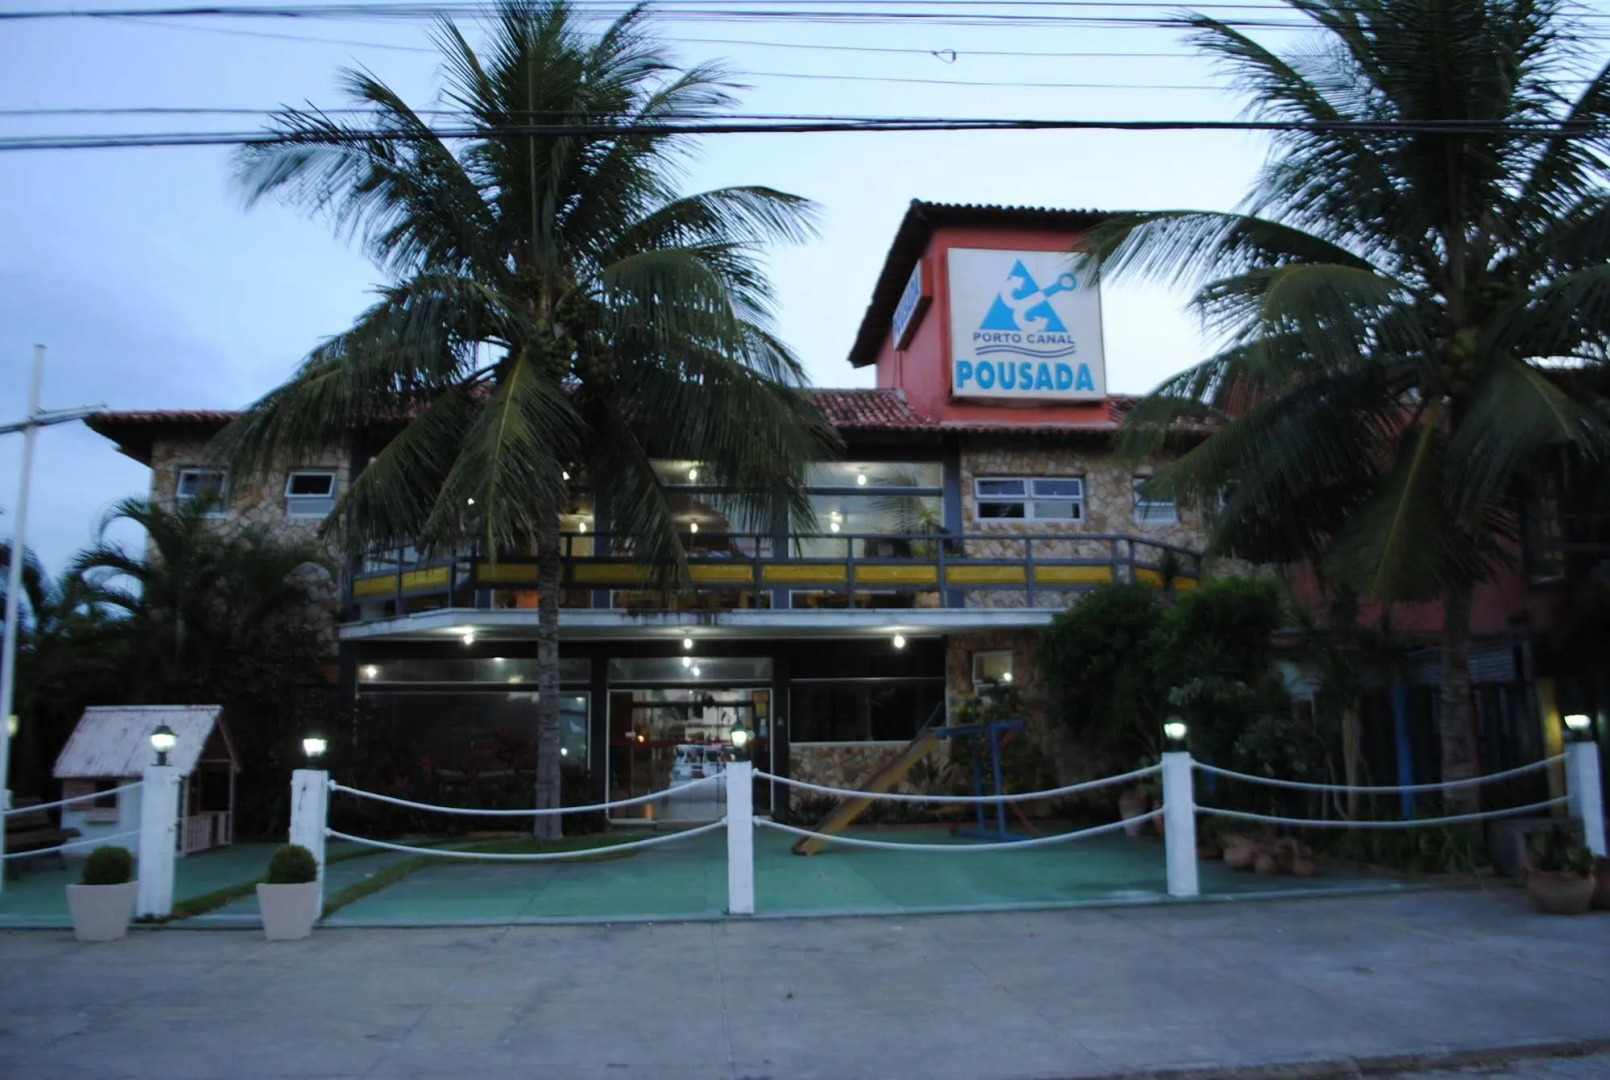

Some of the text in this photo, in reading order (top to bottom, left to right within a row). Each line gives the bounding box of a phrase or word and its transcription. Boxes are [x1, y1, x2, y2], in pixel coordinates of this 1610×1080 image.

[973, 332, 1075, 345] PORTO CANAL
[956, 360, 1095, 391] POUSADA
